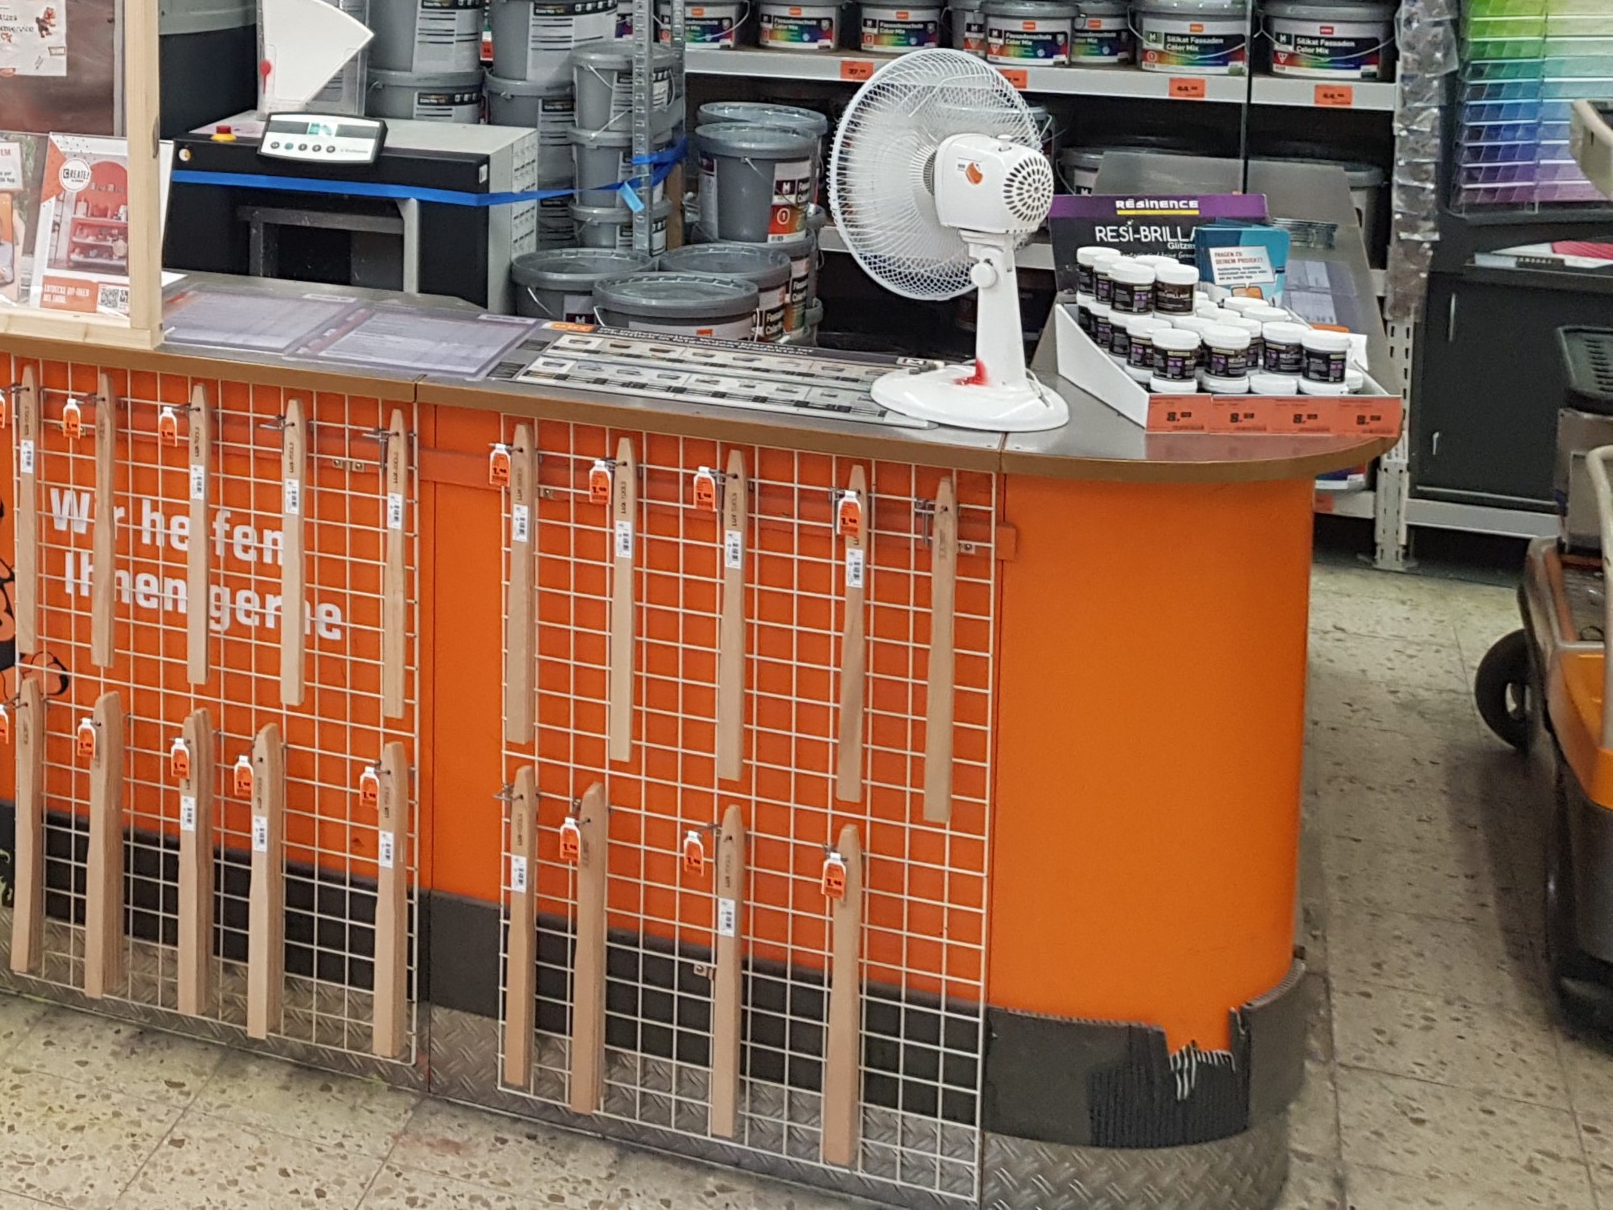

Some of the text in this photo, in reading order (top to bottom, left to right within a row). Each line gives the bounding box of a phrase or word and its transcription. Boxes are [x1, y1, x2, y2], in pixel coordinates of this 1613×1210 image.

[50, 487, 285, 566] Wr hefen
[209, 583, 343, 641] gere
